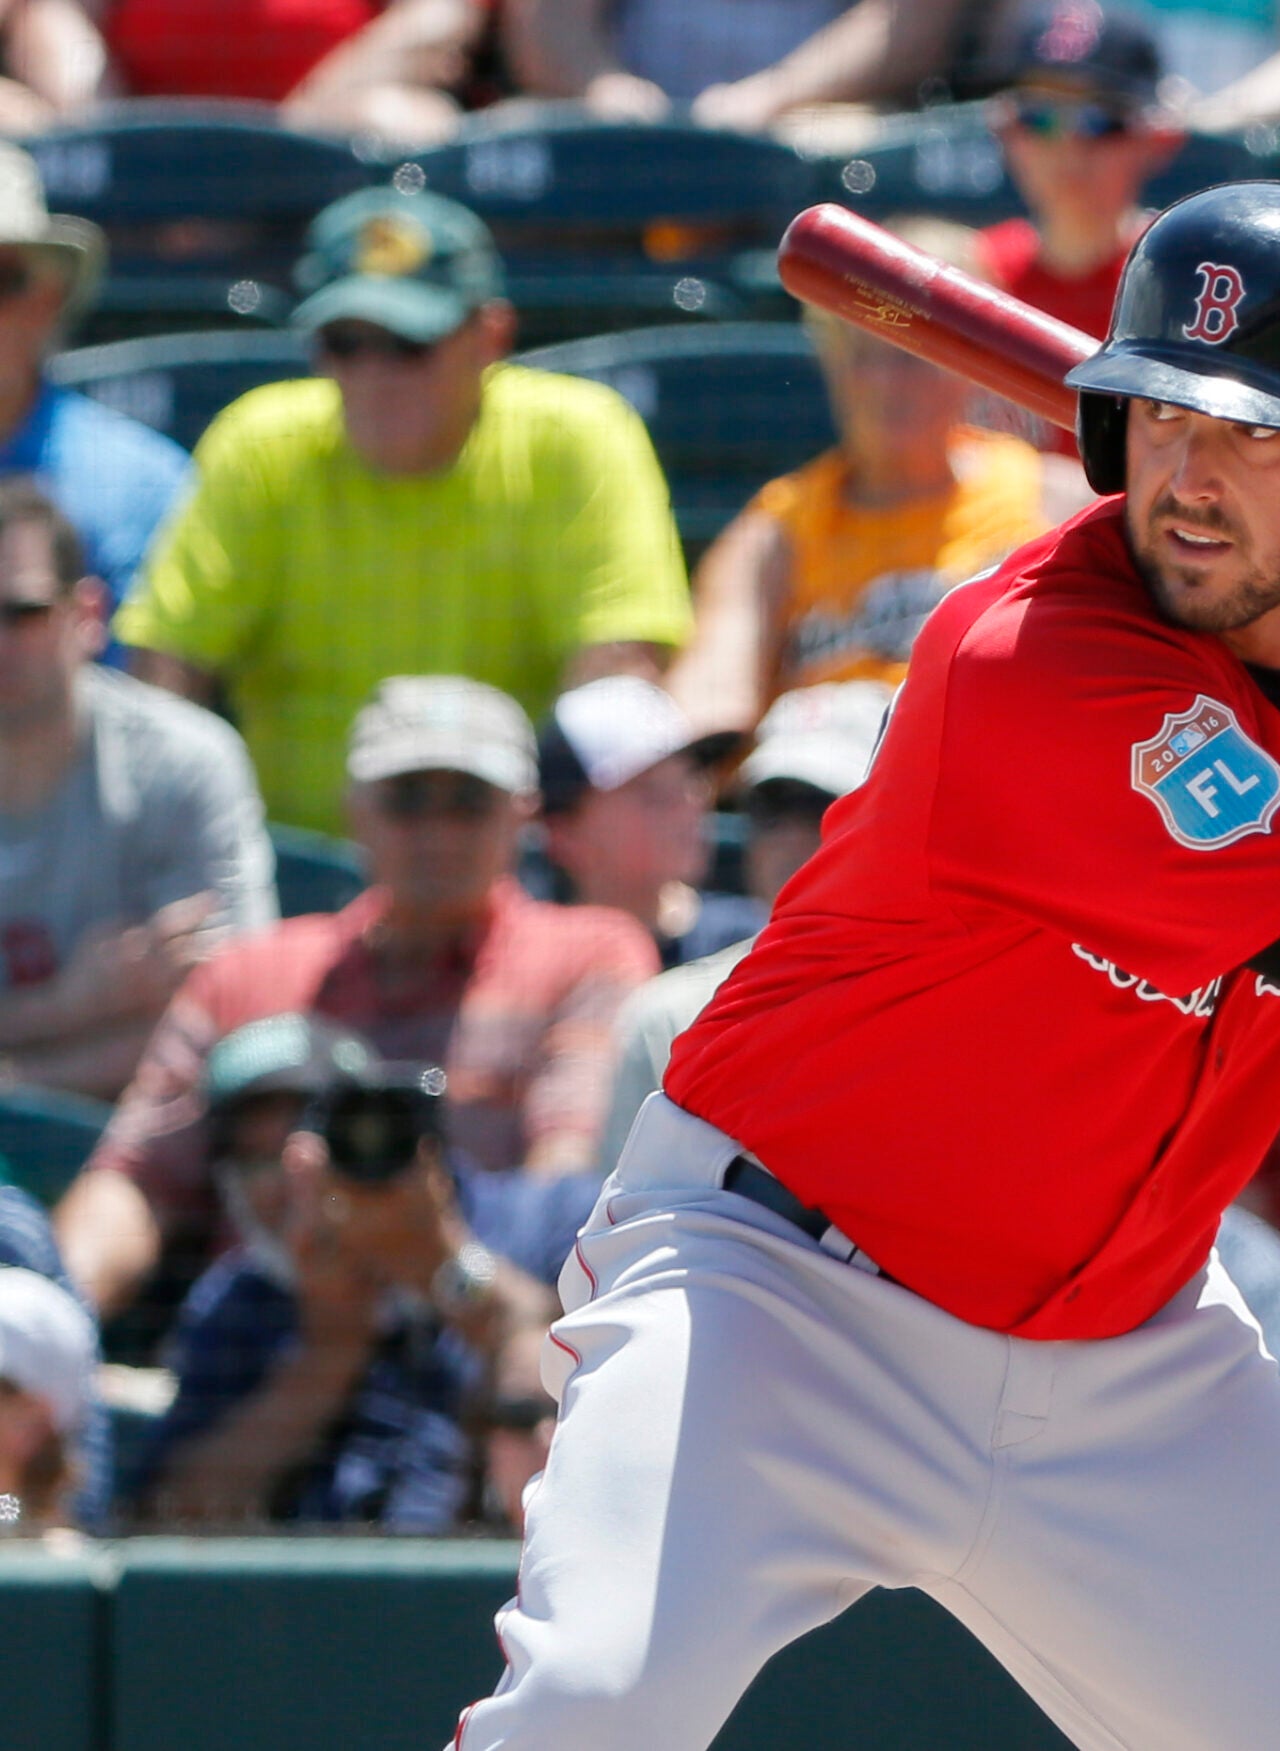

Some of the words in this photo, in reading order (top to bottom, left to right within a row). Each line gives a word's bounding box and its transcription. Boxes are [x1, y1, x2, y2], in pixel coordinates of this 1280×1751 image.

[1182, 262, 1246, 345] B
[1151, 750, 1174, 772] 20
[1202, 716, 1219, 731] 16
[1186, 759, 1260, 818] FL
